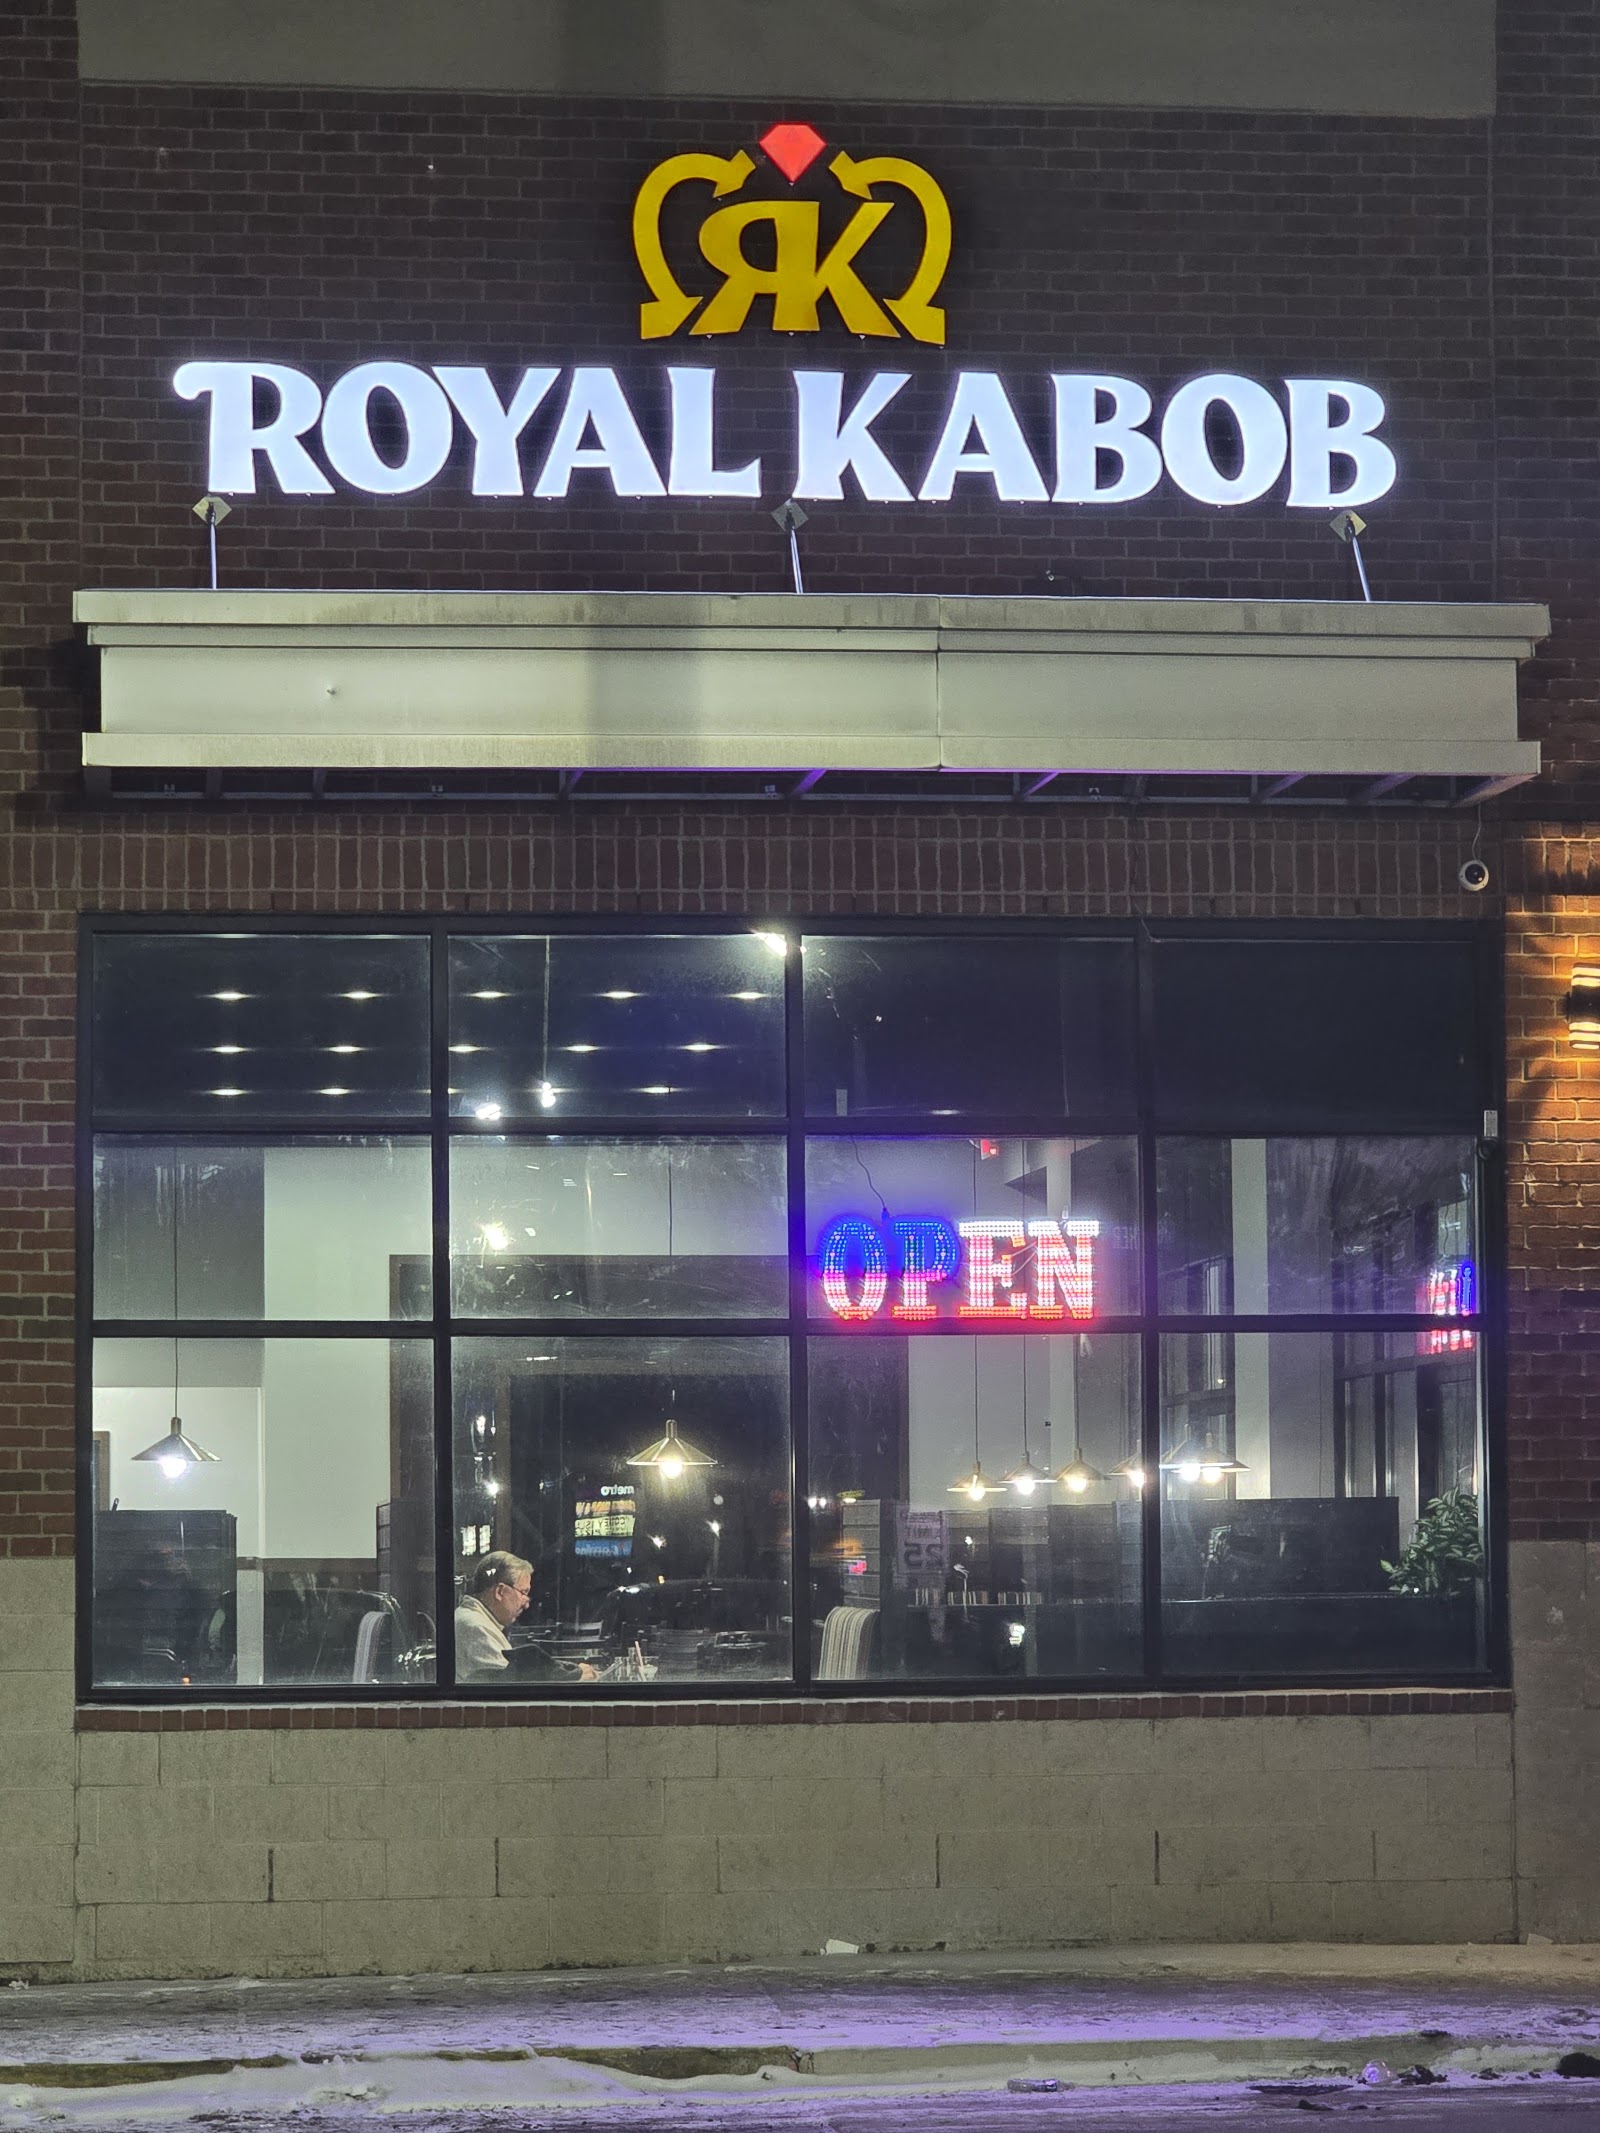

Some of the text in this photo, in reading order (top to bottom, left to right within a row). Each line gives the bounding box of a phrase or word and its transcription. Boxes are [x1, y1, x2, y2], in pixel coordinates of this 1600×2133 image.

[172, 361, 1397, 508] ROYAL KABOB
[822, 1220, 1100, 1320] OPEN
